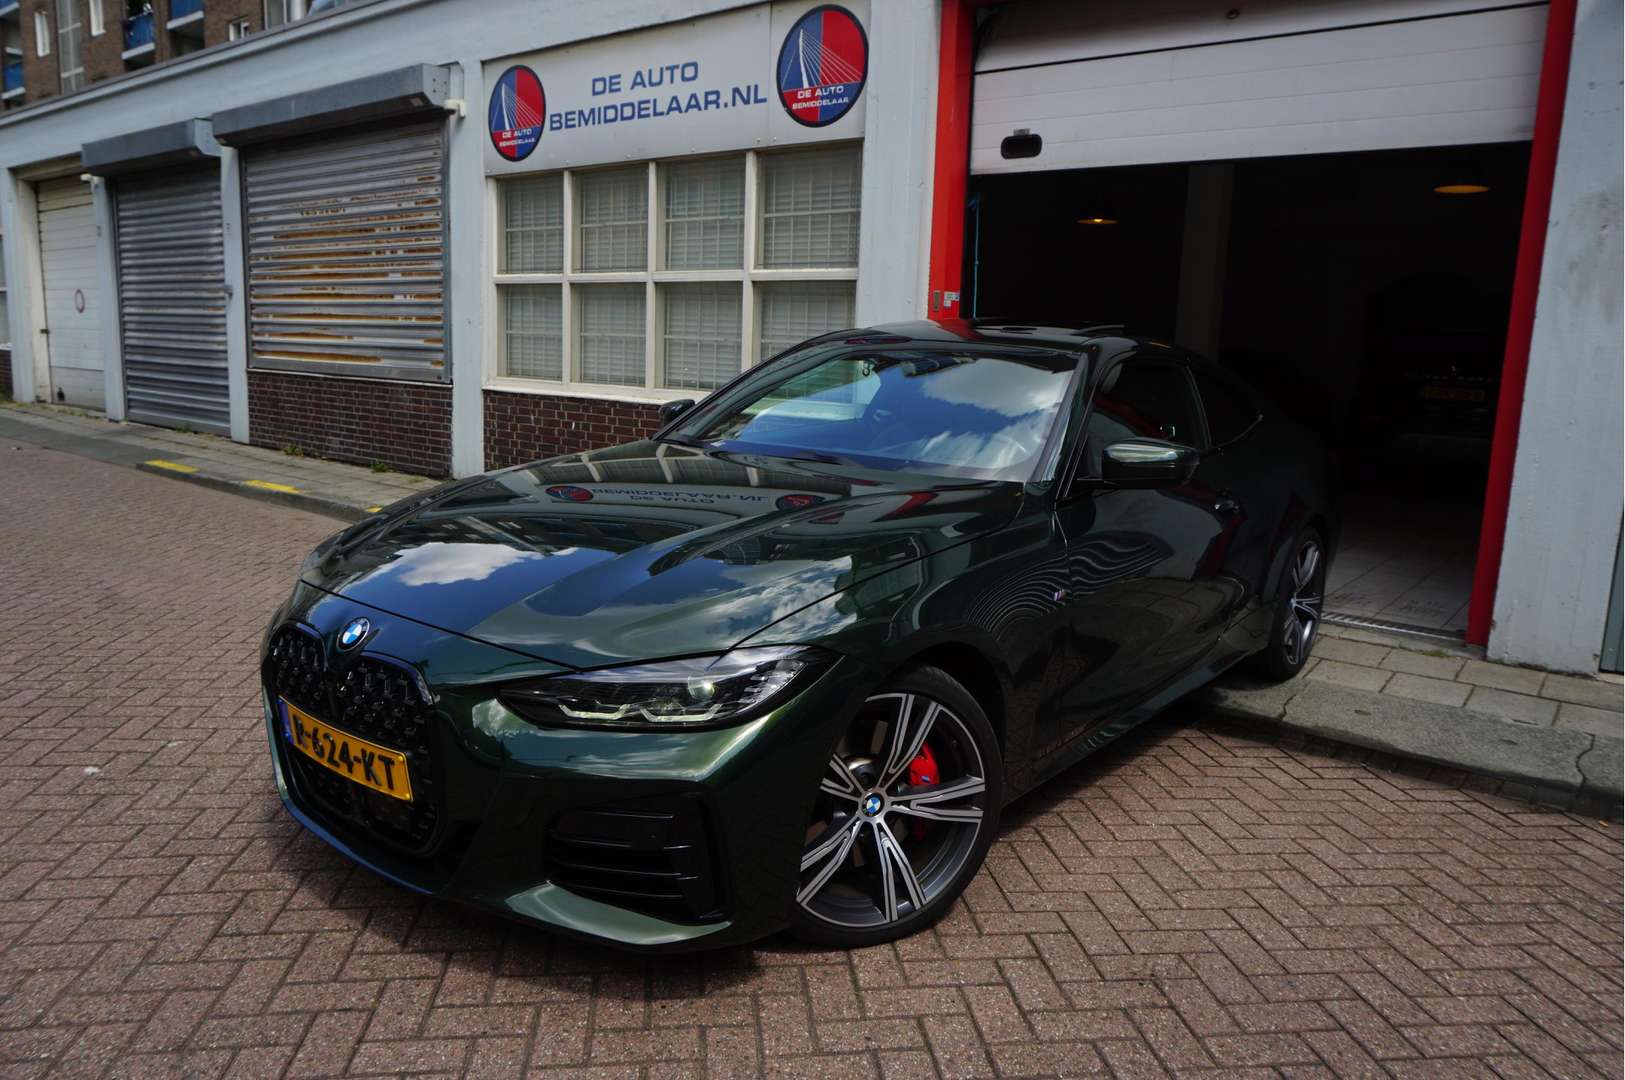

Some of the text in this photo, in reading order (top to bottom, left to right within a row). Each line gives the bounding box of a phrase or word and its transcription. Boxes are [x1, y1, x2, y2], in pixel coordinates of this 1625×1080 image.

[591, 61, 699, 96] DE AUTO
[797, 85, 844, 99] DE AUTO
[549, 84, 768, 131] BEMIDDELAAR.NL
[792, 97, 849, 110] BEMIDDELAAR
[514, 128, 533, 137] AUTO
